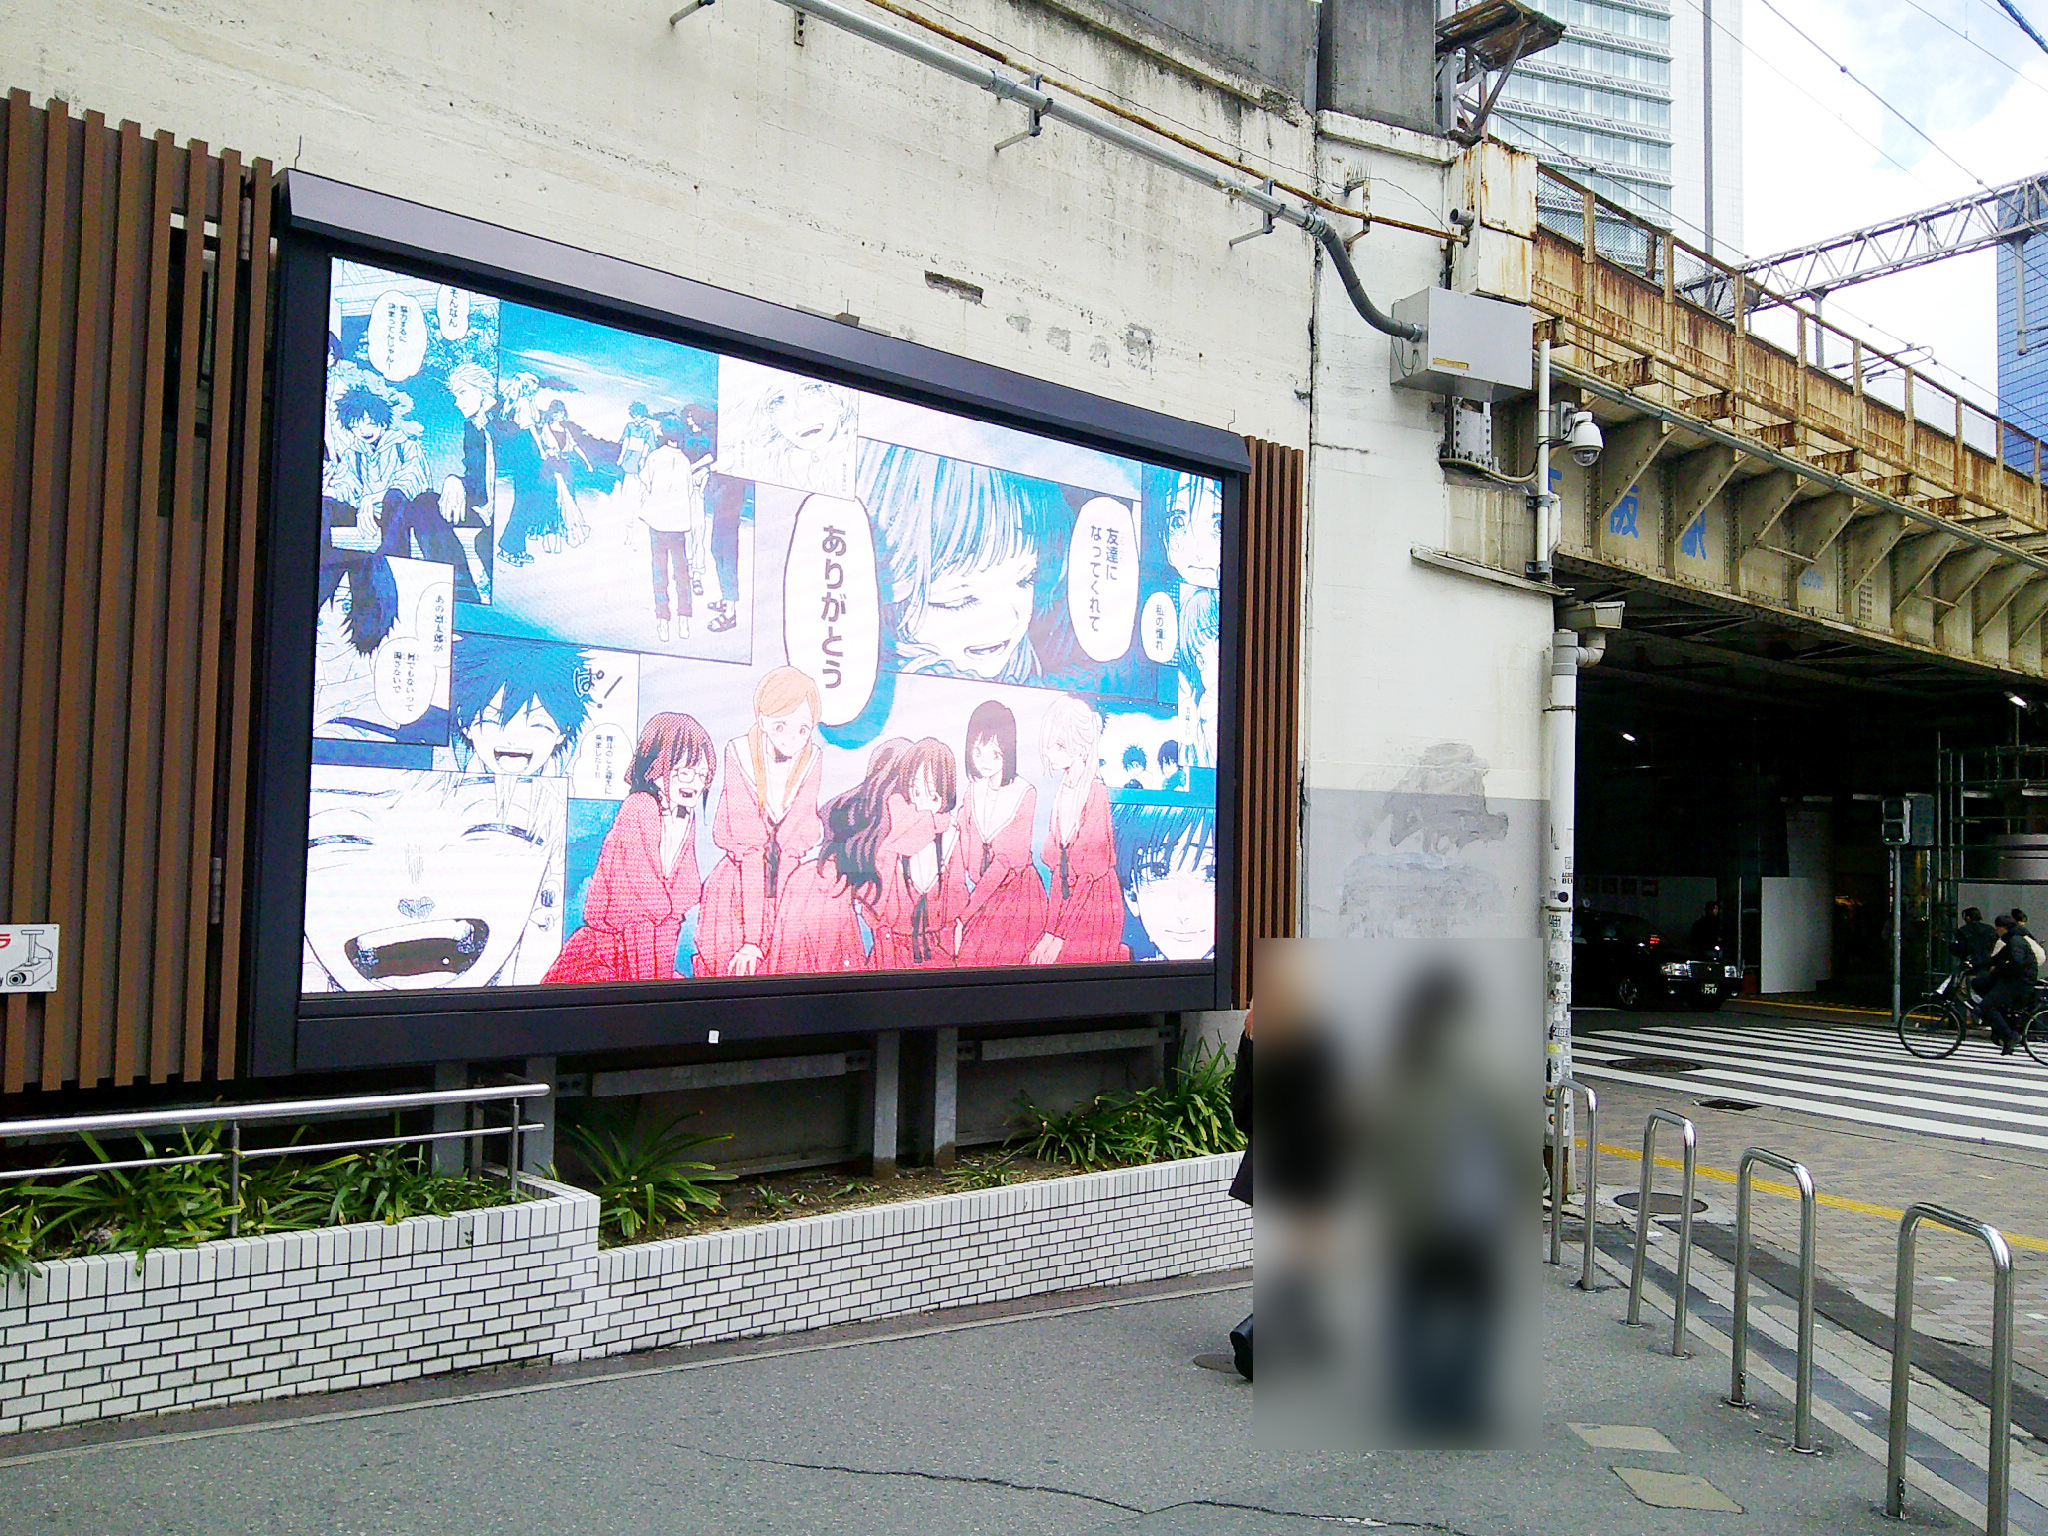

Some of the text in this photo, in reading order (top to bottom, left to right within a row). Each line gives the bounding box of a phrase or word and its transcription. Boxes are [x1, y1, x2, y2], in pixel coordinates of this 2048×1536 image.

[820, 525, 847, 689] ありがとう
[1089, 524, 1102, 633] なってくれて
[1106, 527, 1119, 581] 友達に
